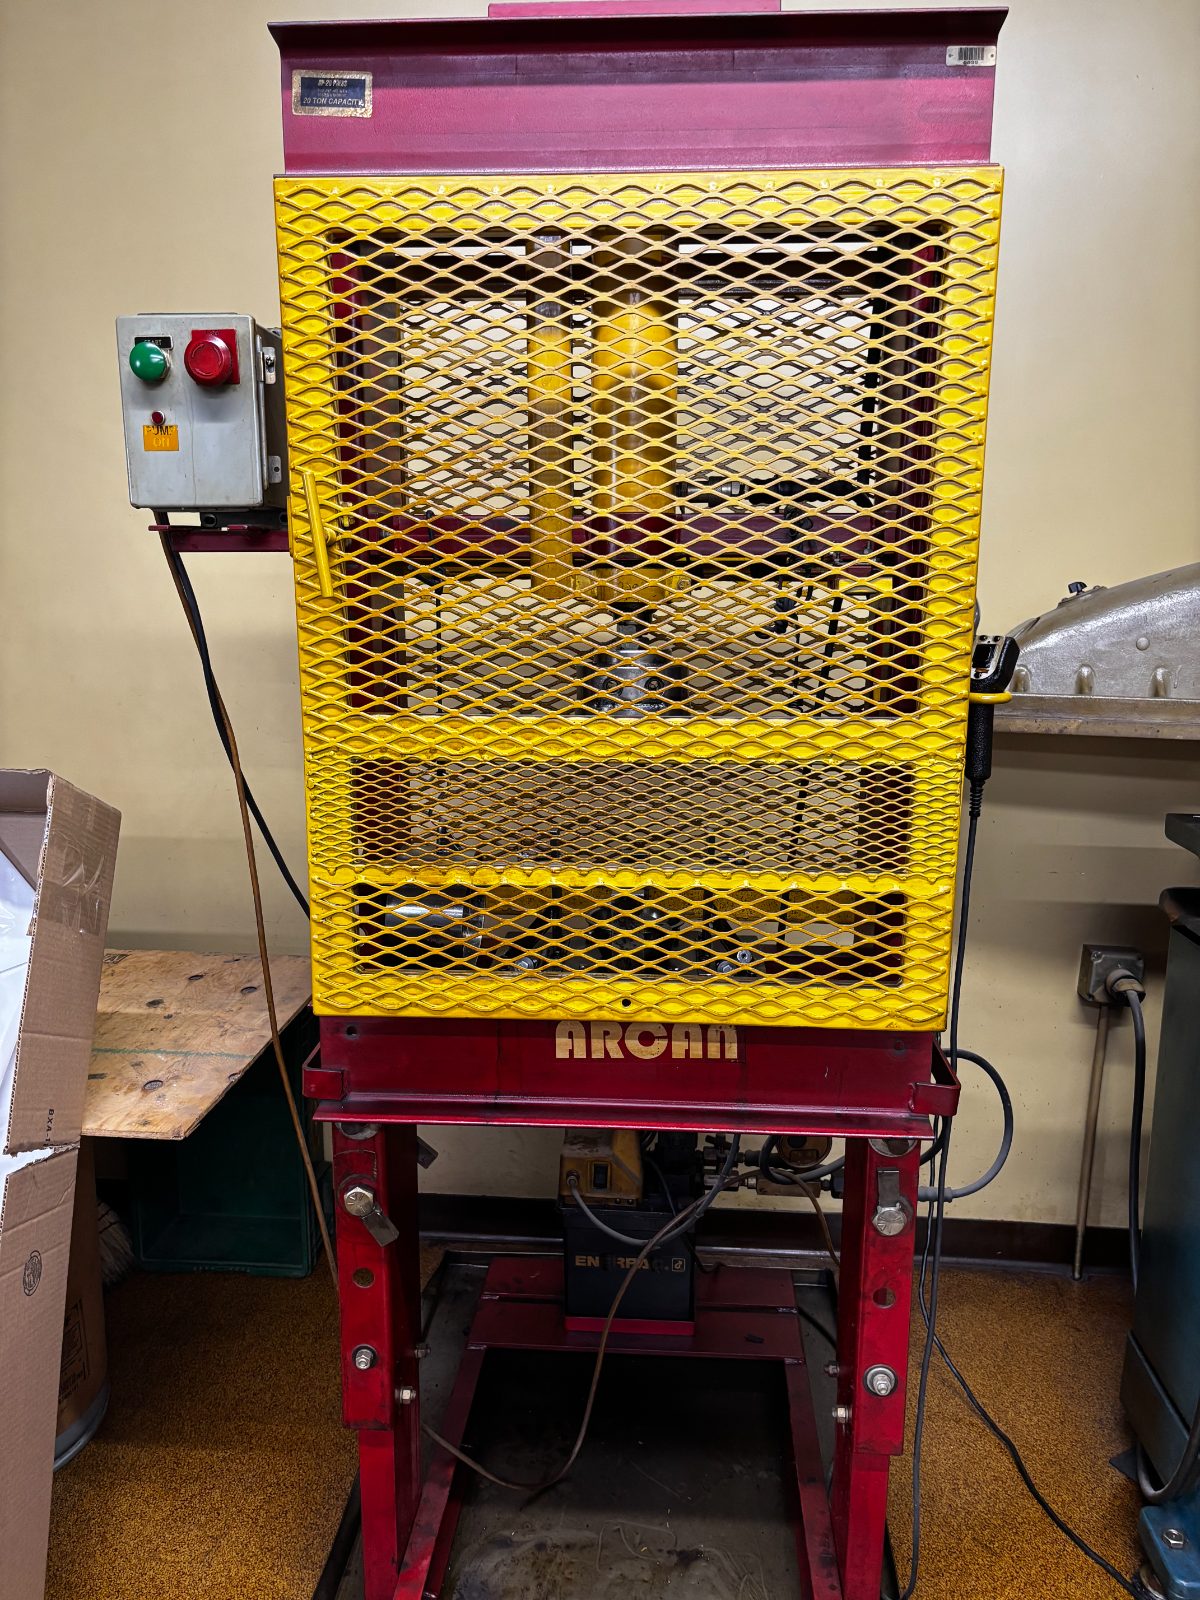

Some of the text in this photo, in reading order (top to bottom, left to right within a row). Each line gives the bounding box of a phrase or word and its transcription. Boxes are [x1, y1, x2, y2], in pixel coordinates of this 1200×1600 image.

[328, 98, 364, 106] CAPACITY
[153, 437, 170, 448] ON
[555, 1020, 738, 1060] ARCAN
[575, 1255, 663, 1270] ENRPA
